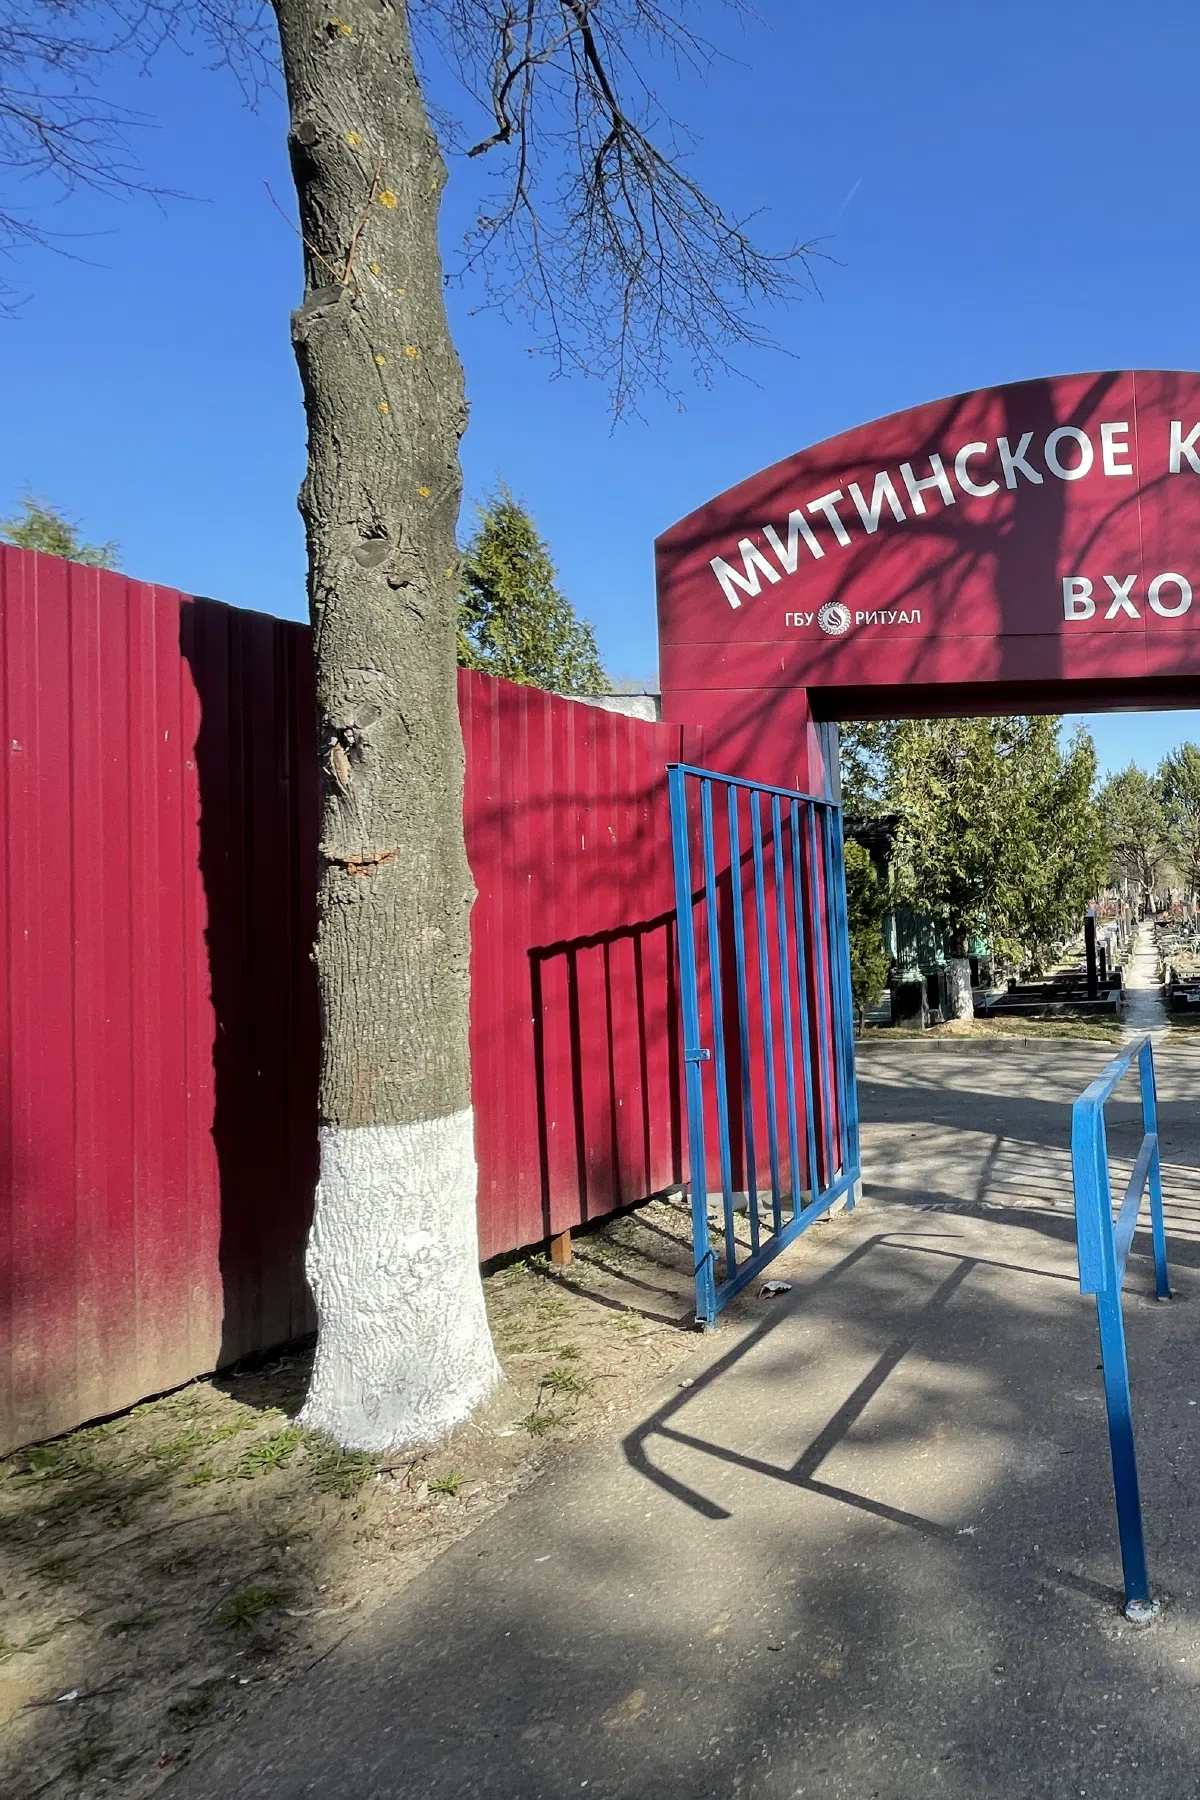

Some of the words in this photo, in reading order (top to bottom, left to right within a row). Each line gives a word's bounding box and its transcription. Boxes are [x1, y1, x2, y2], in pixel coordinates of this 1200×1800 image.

[709, 421, 1134, 610] МИТИНСКОЕ
[784, 612, 814, 627] ГБУ
[855, 609, 921, 625] РИТУАЛ
